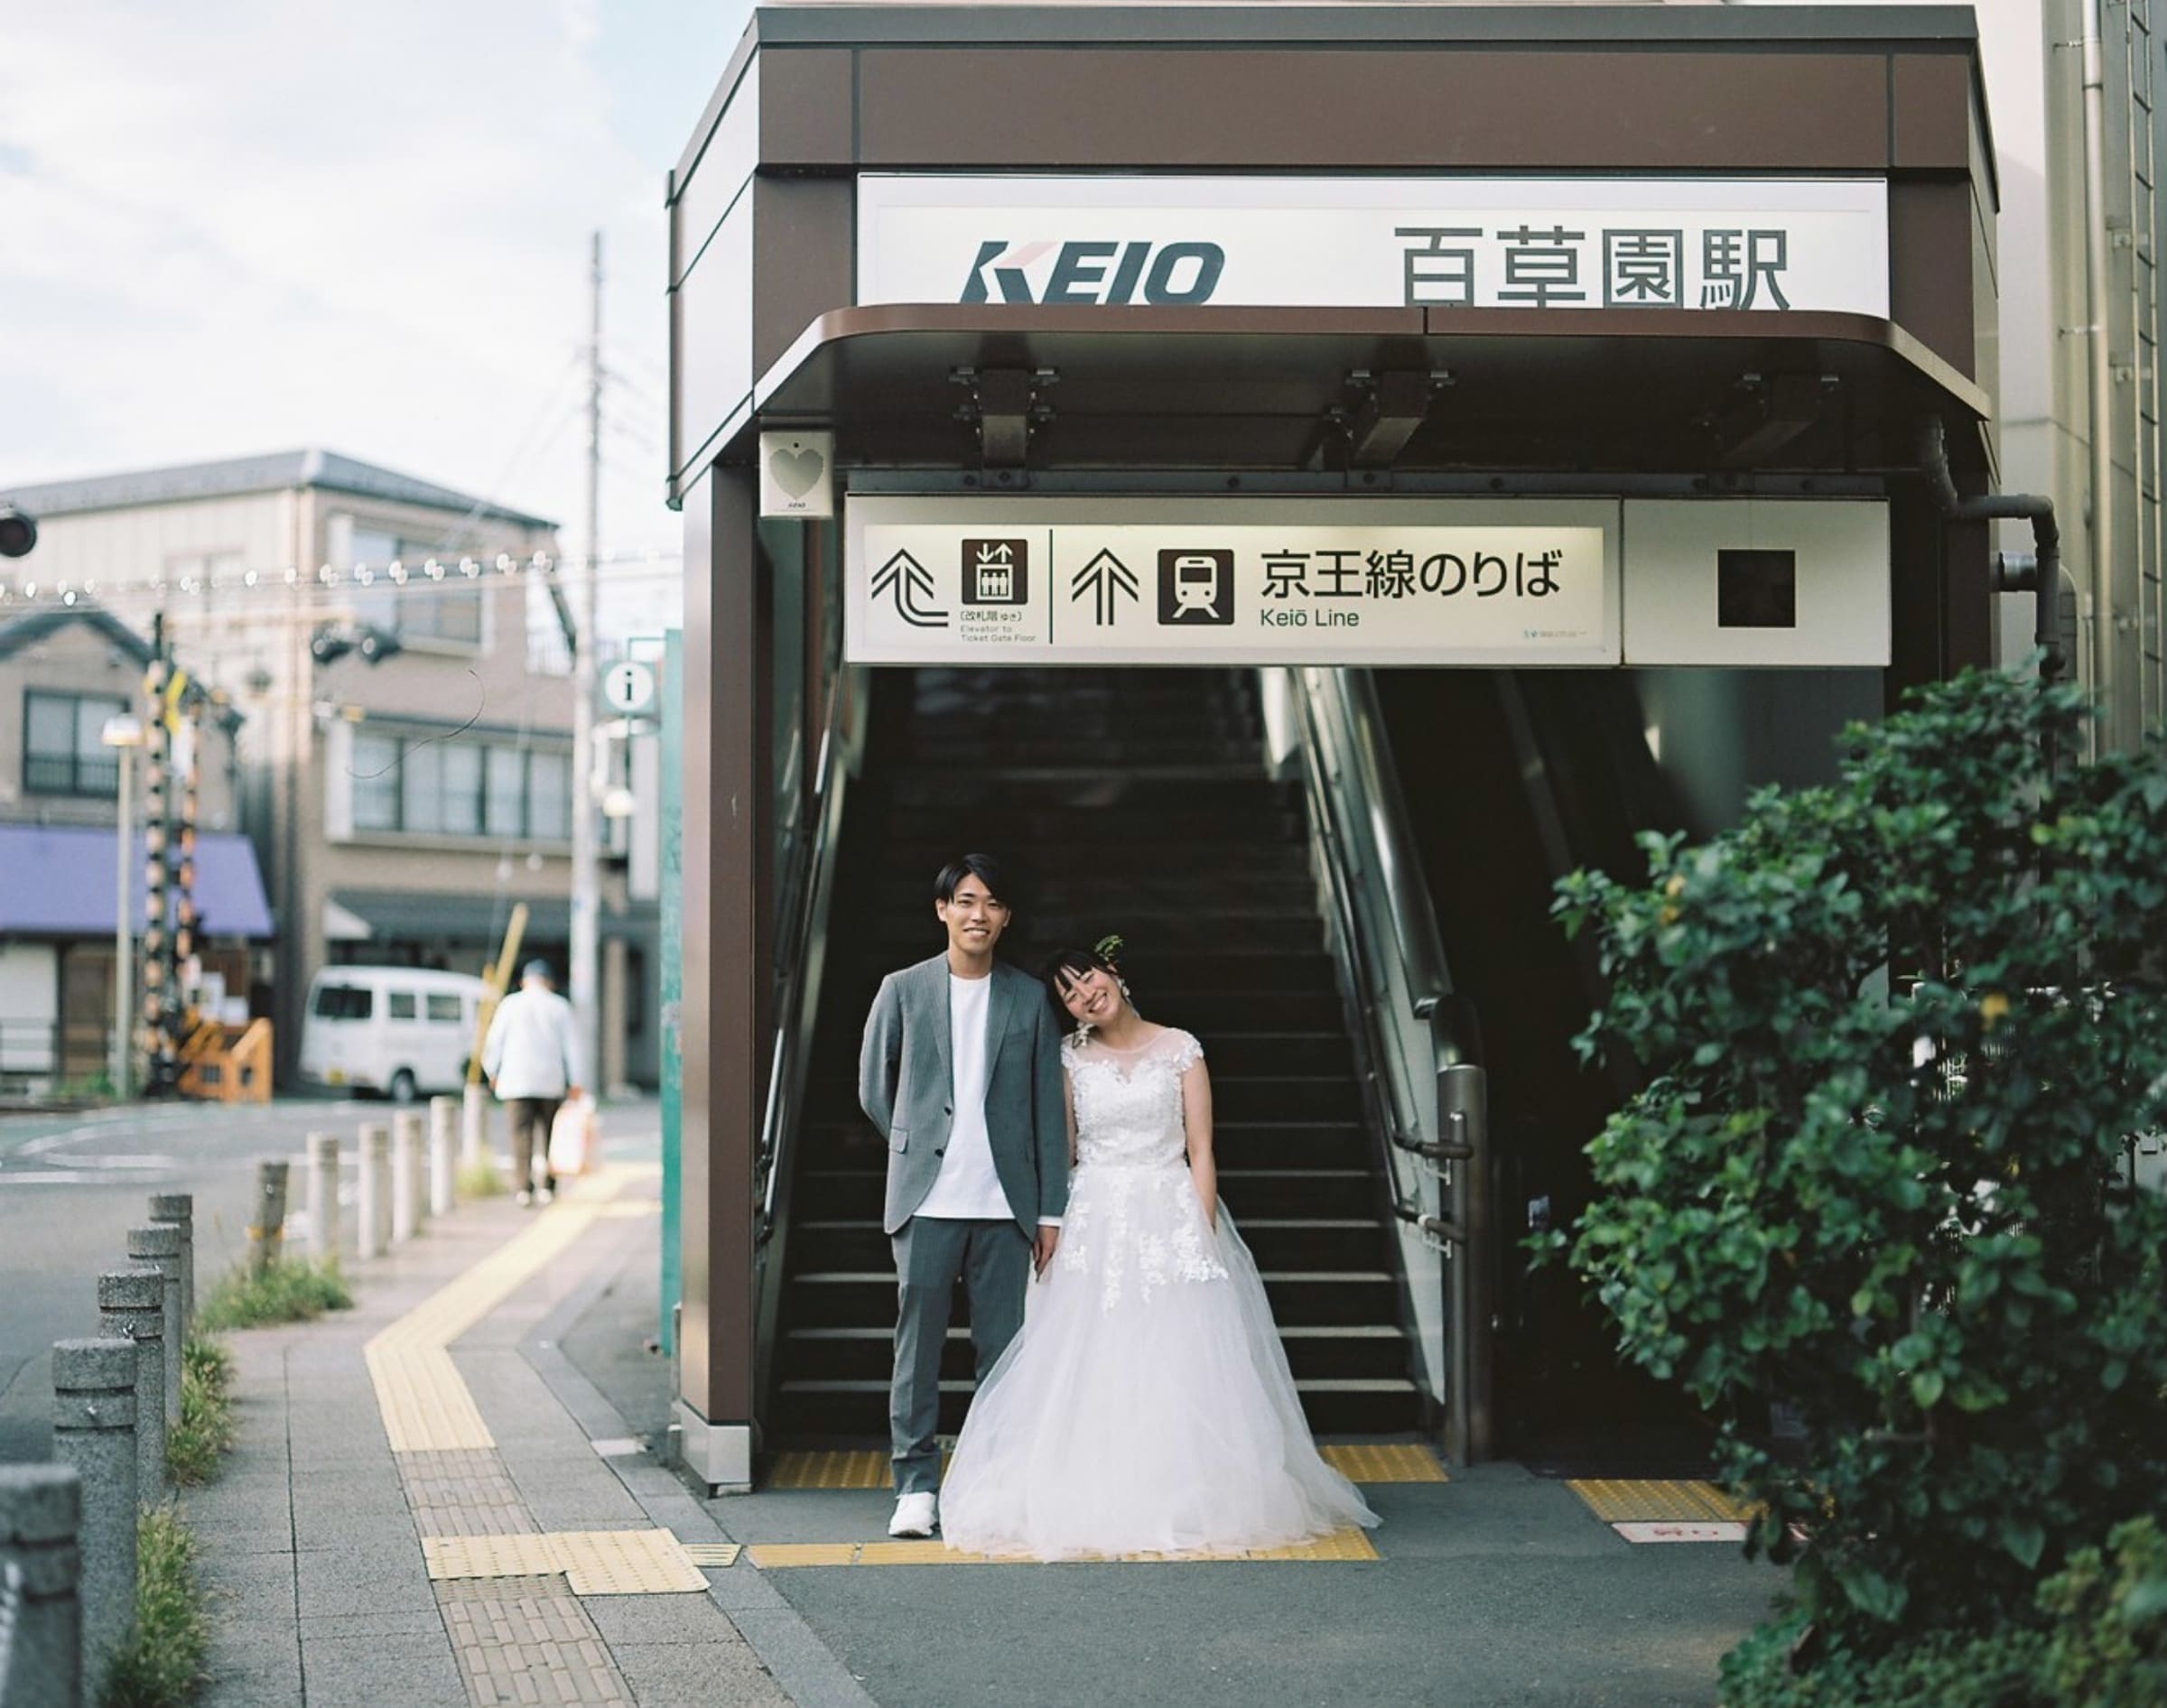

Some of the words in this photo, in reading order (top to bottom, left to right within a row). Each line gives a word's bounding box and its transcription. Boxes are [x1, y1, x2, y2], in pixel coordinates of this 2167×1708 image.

[960, 240, 1225, 304] KEIO
[1395, 226, 1790, 311] 百草園駅
[1261, 549, 1563, 599] 京王線のりば
[1260, 608, 1307, 627] Keiō
[1316, 608, 1359, 627] Line
